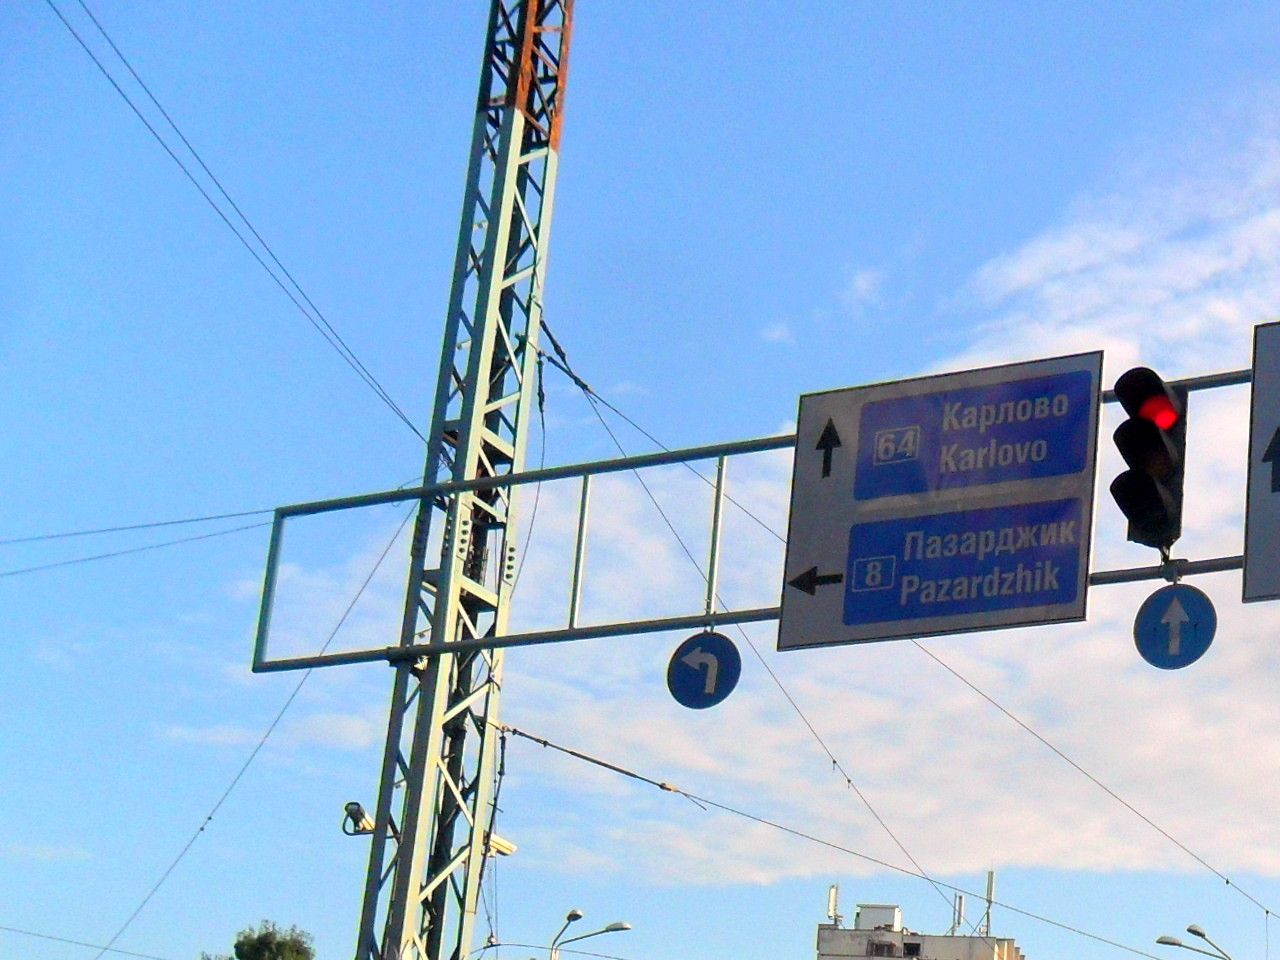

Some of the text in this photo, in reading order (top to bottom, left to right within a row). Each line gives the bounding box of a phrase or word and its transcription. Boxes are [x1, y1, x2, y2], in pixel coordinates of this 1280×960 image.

[941, 392, 1069, 433] Карлово
[877, 429, 915, 461] 64
[938, 437, 1048, 474] Karlovo
[903, 518, 1079, 562] Пазарджик
[864, 560, 882, 587] 8
[900, 560, 1060, 606] Pazardzhik
